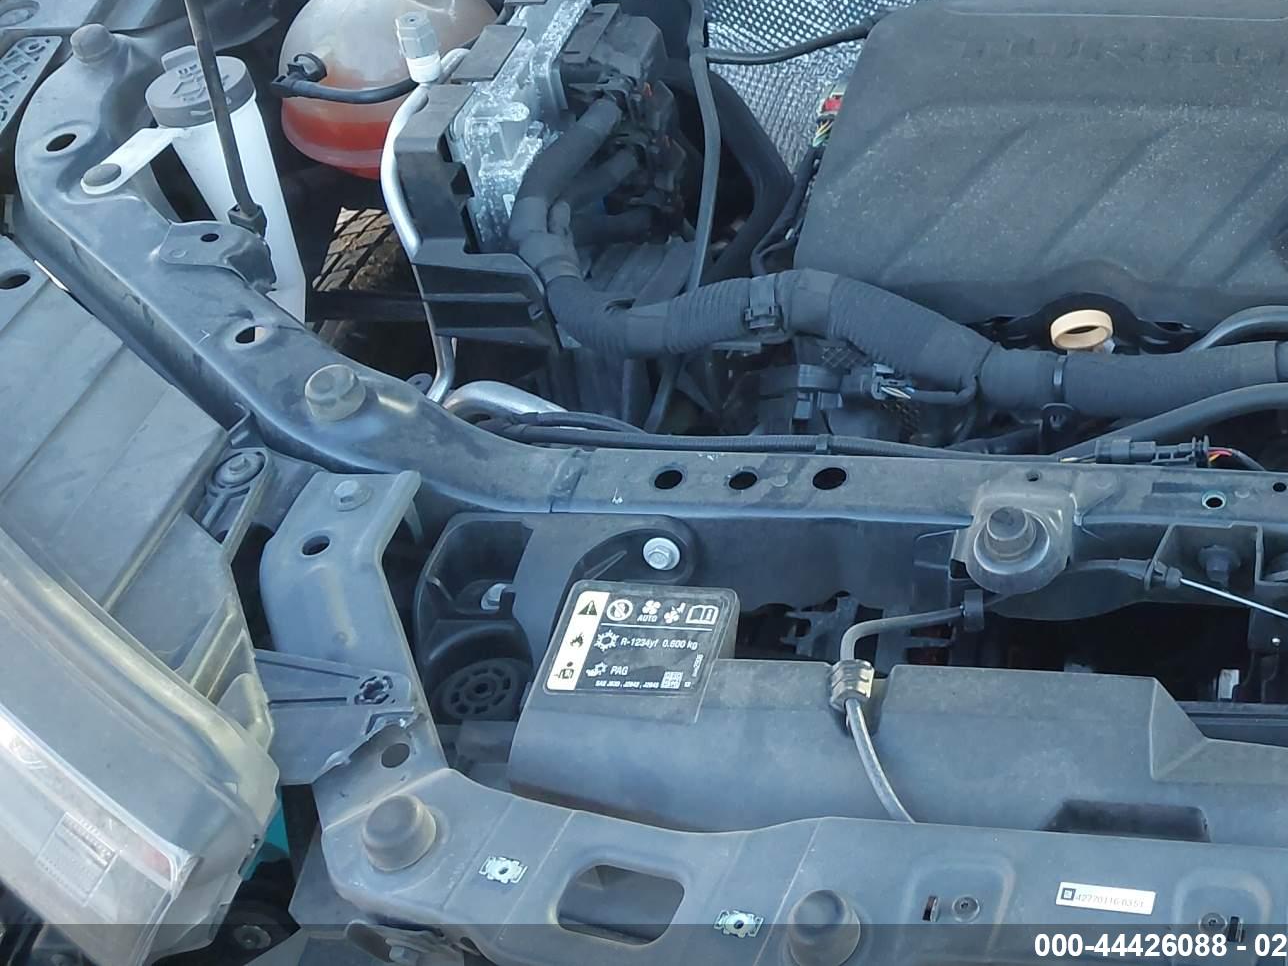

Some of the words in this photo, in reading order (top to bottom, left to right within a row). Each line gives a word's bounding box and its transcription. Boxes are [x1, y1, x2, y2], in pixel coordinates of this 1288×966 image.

[637, 614, 658, 623] AUTO
[620, 637, 658, 648] R-1234yf
[662, 639, 686, 649] 0.600
[687, 640, 698, 651] kg
[610, 665, 629, 675] PAG
